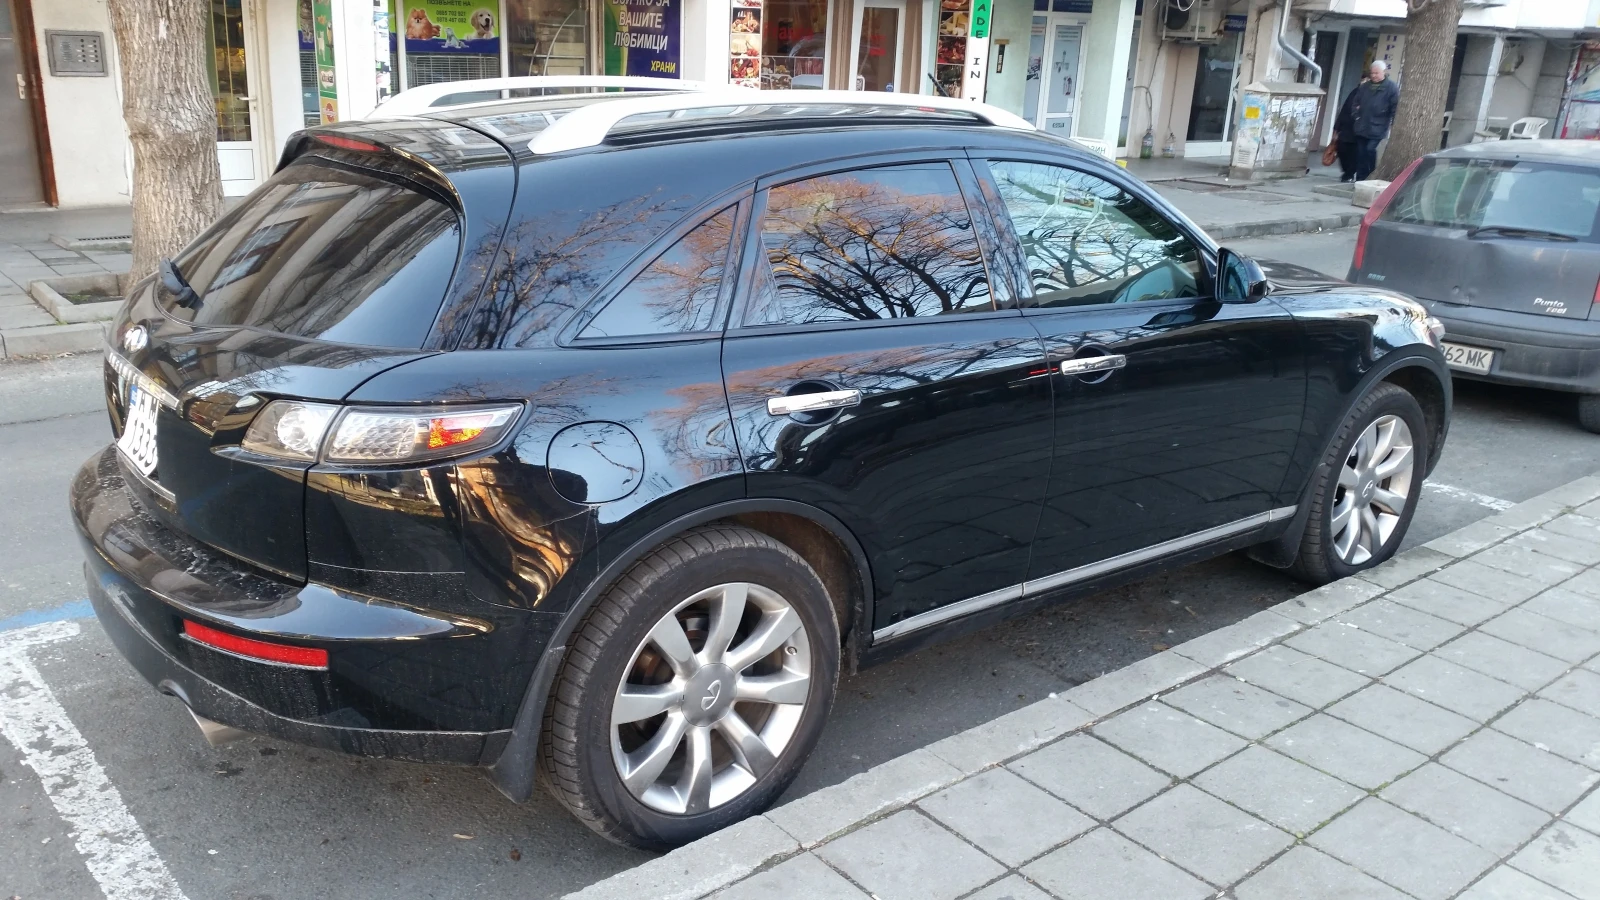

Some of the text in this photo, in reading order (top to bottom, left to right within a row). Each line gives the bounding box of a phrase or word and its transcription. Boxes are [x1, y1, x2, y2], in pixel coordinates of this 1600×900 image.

[619, 11, 663, 29] ВАШИТЕ
[614, 31, 668, 53] ЛЮБИМЦИ
[651, 60, 676, 73] ХРАНИ
[1533, 297, 1565, 308] Punto
